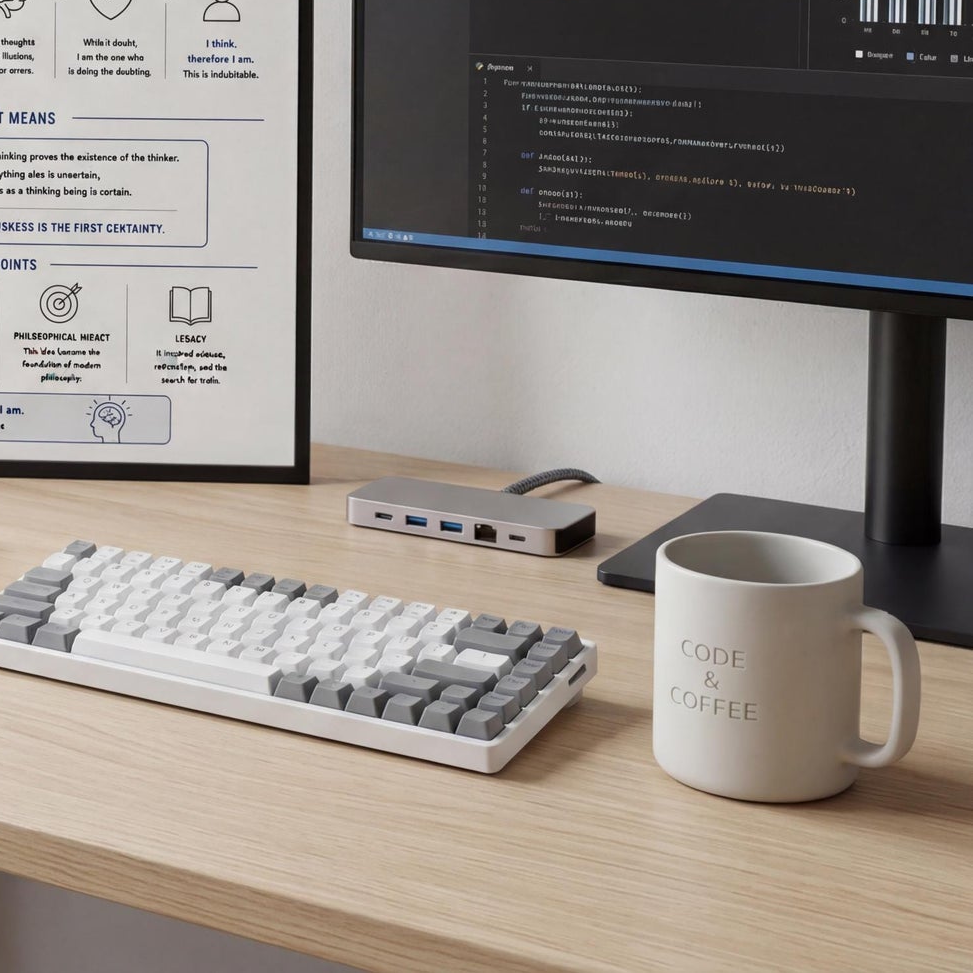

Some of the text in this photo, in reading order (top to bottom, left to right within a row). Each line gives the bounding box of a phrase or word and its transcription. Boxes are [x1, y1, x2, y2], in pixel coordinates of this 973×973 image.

[95, 53, 109, 61] the
[187, 54, 229, 63] therefore
[238, 56, 254, 64] am.
[68, 67, 75, 75] is
[100, 67, 114, 75] the
[183, 70, 200, 78] This
[202, 70, 209, 78] is
[9, 112, 55, 124] MEANS
[60, 153, 75, 161] the
[77, 153, 118, 161] existence
[119, 153, 129, 161] of
[131, 153, 145, 161] the
[147, 154, 179, 162] thinker.
[25, 187, 61, 197] thinking
[63, 187, 87, 197] being
[90, 187, 98, 195] is
[38, 223, 48, 232] IS
[51, 223, 71, 232] THE
[74, 223, 103, 232] FIRST
[6, 407, 24, 415] am.
[681, 639, 745, 669] CODE
[704, 670, 719, 690] &
[670, 686, 758, 721] COFFEE
